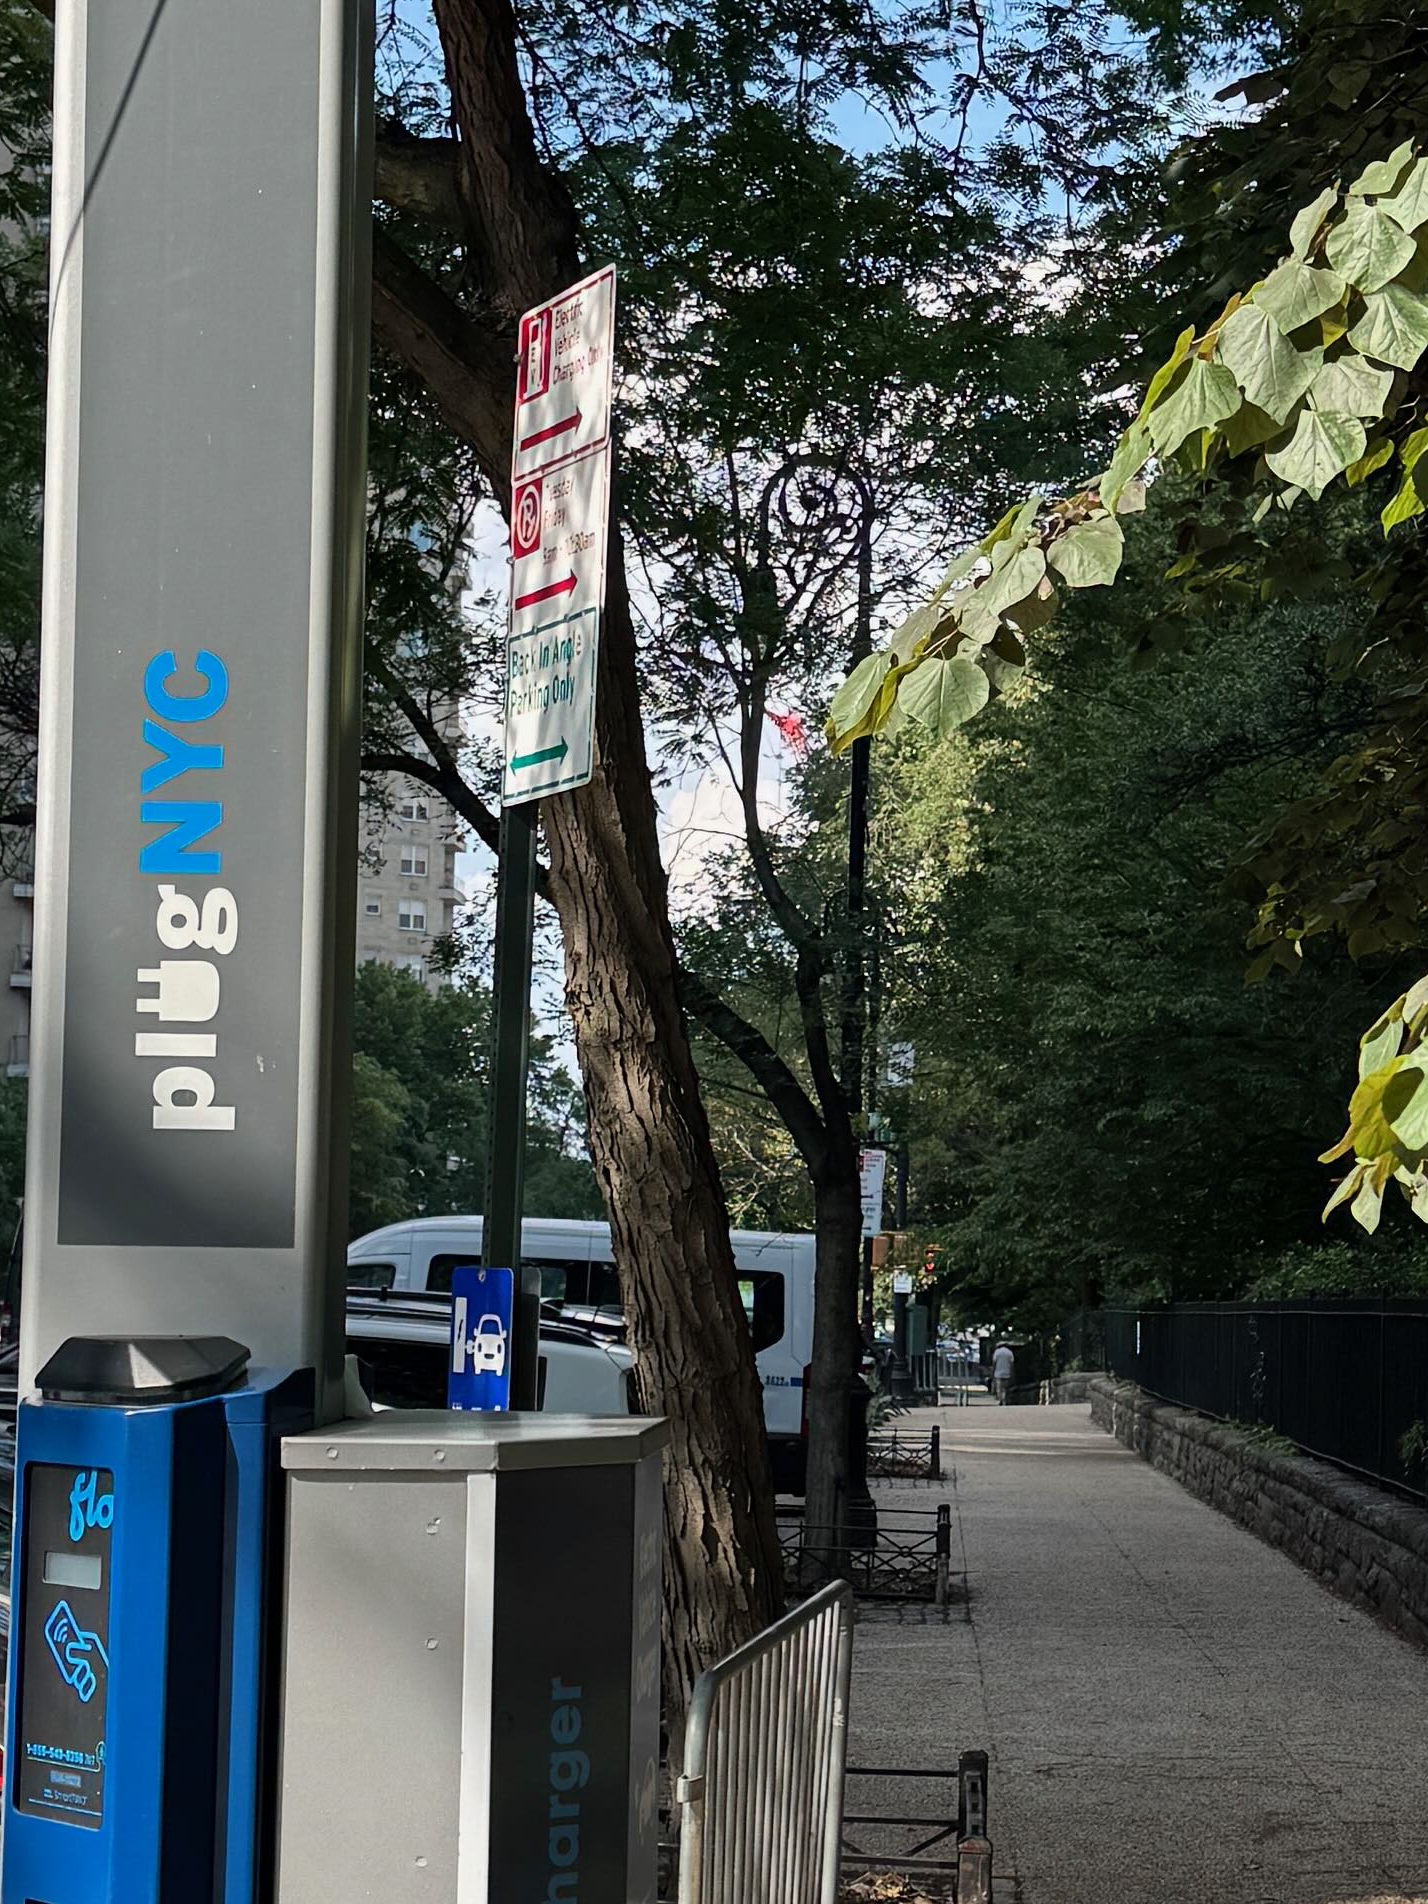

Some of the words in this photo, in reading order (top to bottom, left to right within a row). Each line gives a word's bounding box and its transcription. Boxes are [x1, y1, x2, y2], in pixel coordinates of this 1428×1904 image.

[512, 646, 538, 680] Back
[538, 640, 550, 670] In
[551, 629, 583, 666] Angle
[510, 682, 550, 717] Parking
[552, 671, 576, 706] Only
[68, 1470, 114, 1543] flo
